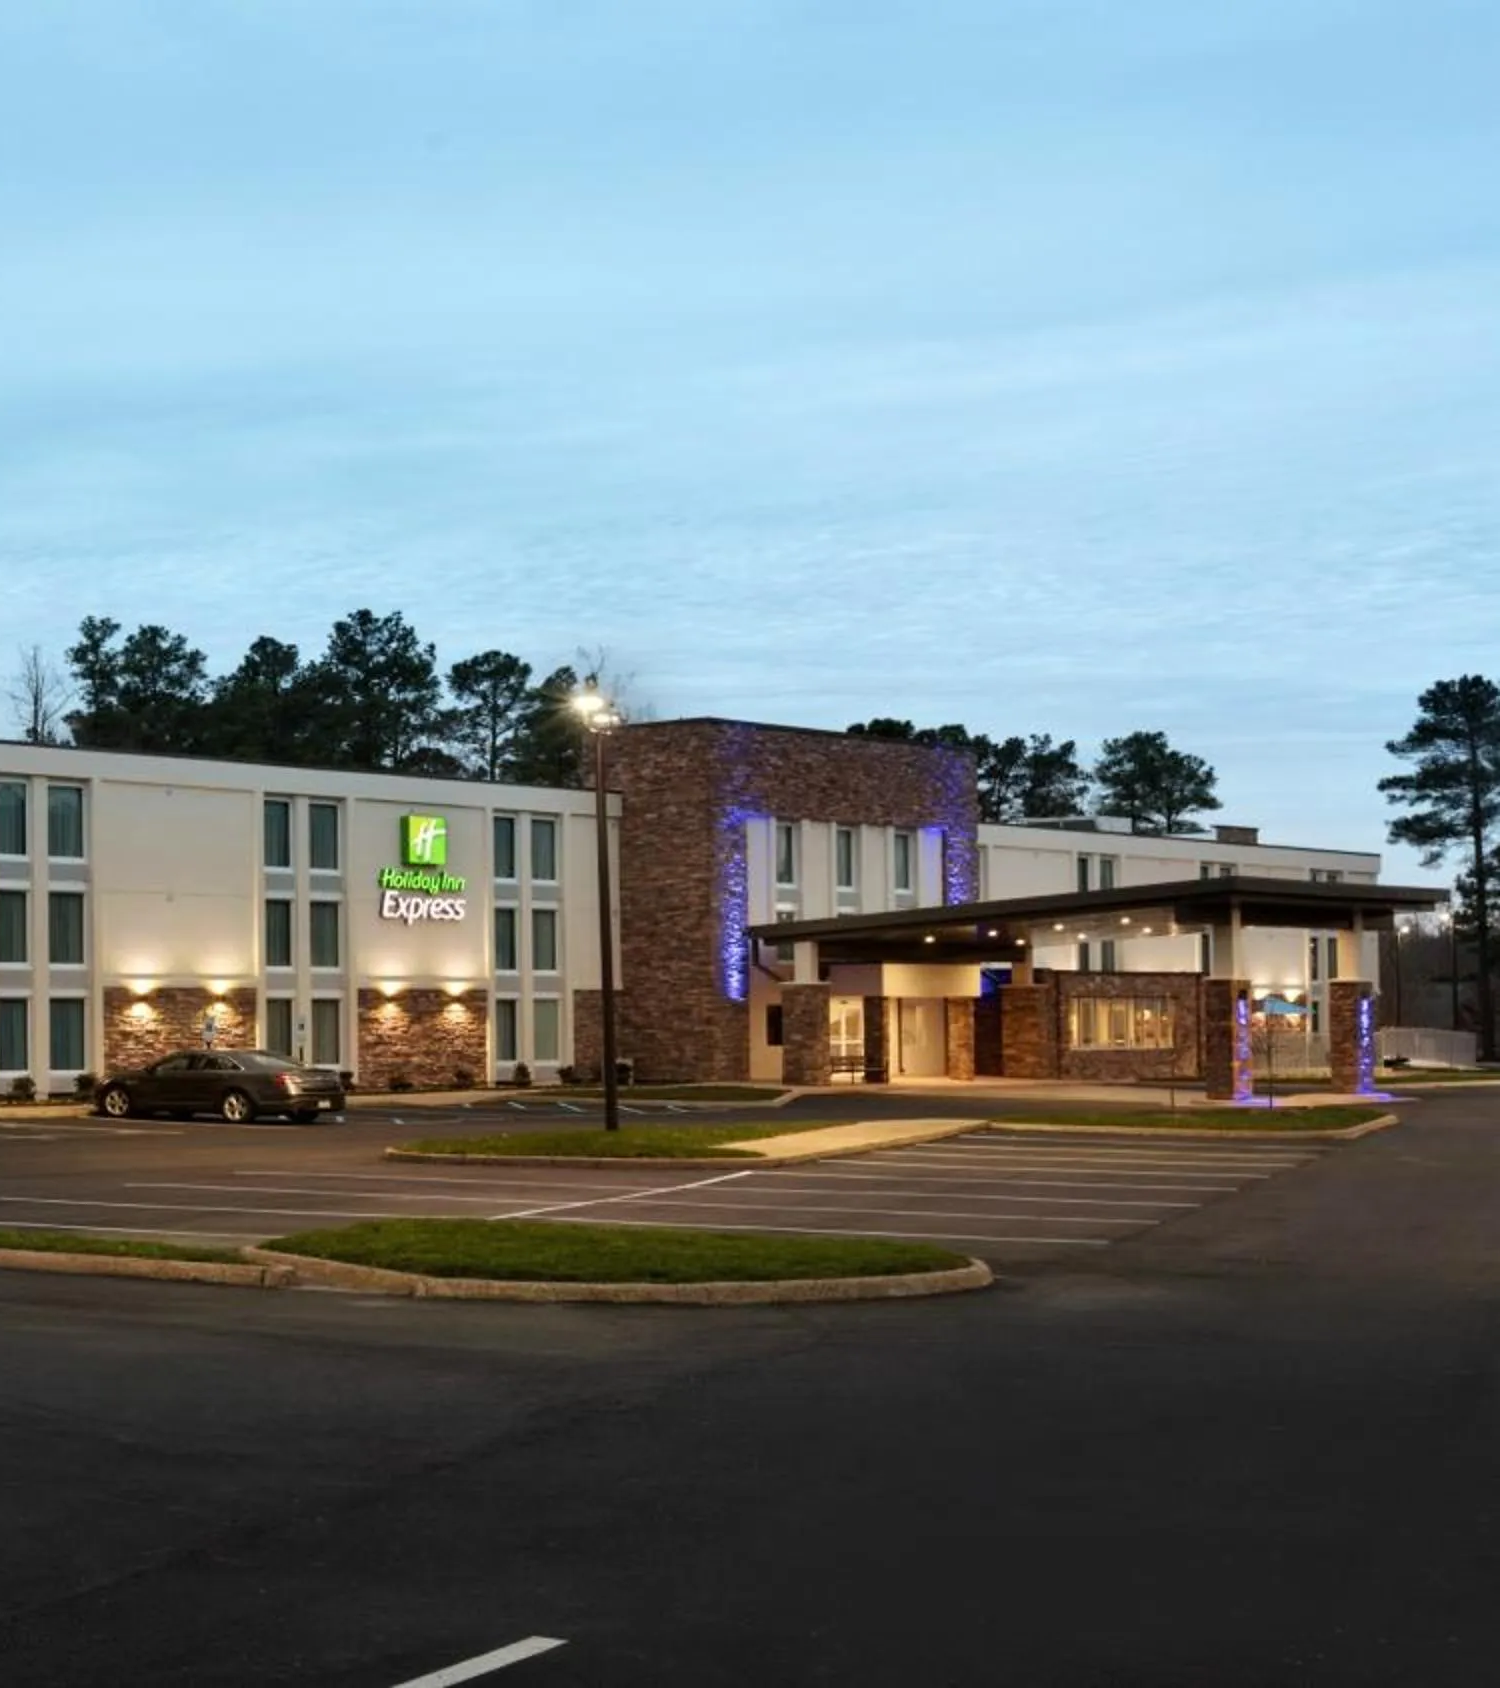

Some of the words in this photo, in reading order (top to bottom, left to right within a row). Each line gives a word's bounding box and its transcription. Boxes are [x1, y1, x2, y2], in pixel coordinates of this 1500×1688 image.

[381, 868, 439, 894] Holiday
[441, 872, 466, 891] Inn
[382, 889, 467, 925] Express
